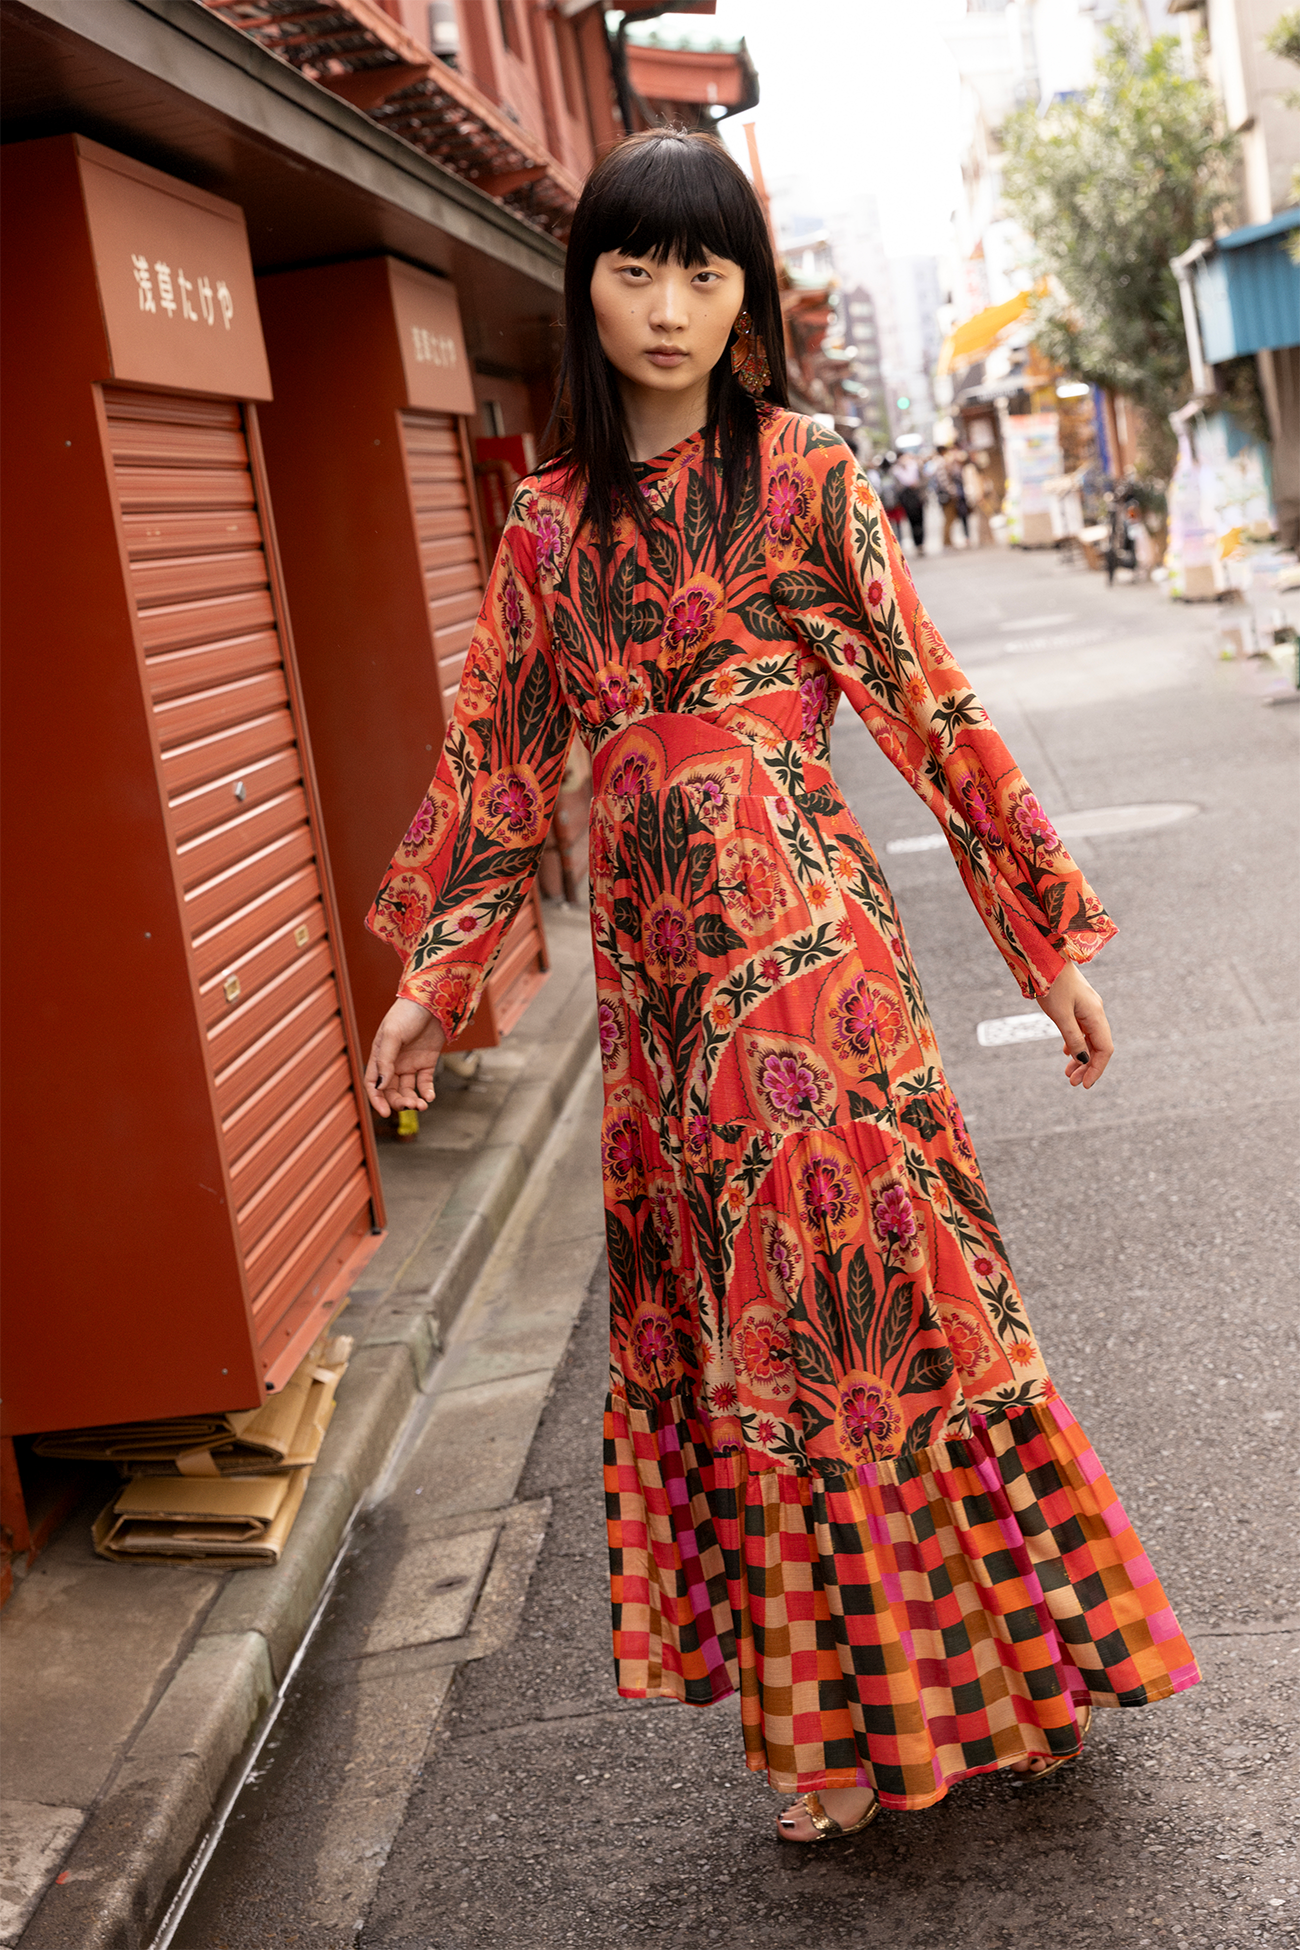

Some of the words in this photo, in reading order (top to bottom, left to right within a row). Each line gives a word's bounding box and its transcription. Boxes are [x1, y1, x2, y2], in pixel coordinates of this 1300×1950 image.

[131, 253, 234, 331] 浅草たけや
